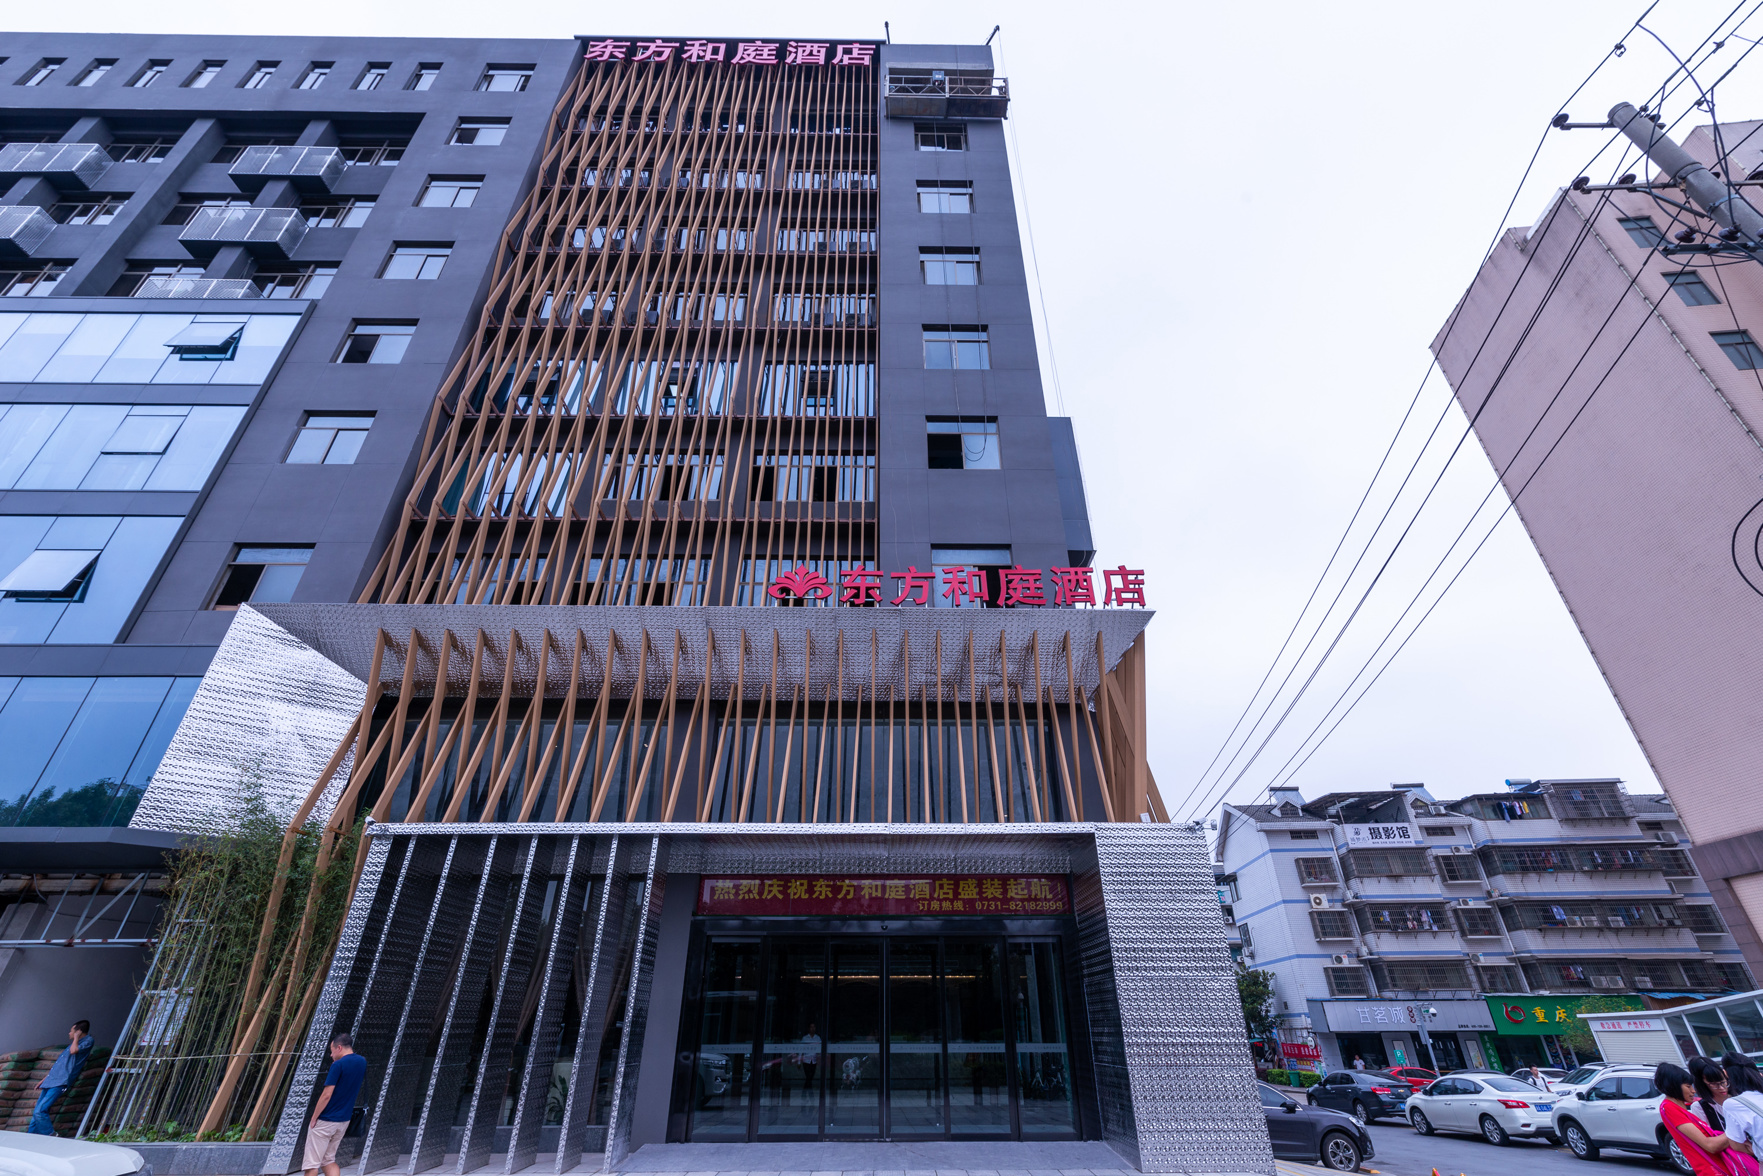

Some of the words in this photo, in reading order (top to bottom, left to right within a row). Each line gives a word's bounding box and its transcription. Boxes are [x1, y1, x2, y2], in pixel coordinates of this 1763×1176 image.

[584, 39, 876, 66] 东方和庭酒店
[840, 564, 1146, 607] 东方和庭酒店
[1368, 826, 1410, 840] 摄影馆
[1531, 1005, 1571, 1022] 重庆
